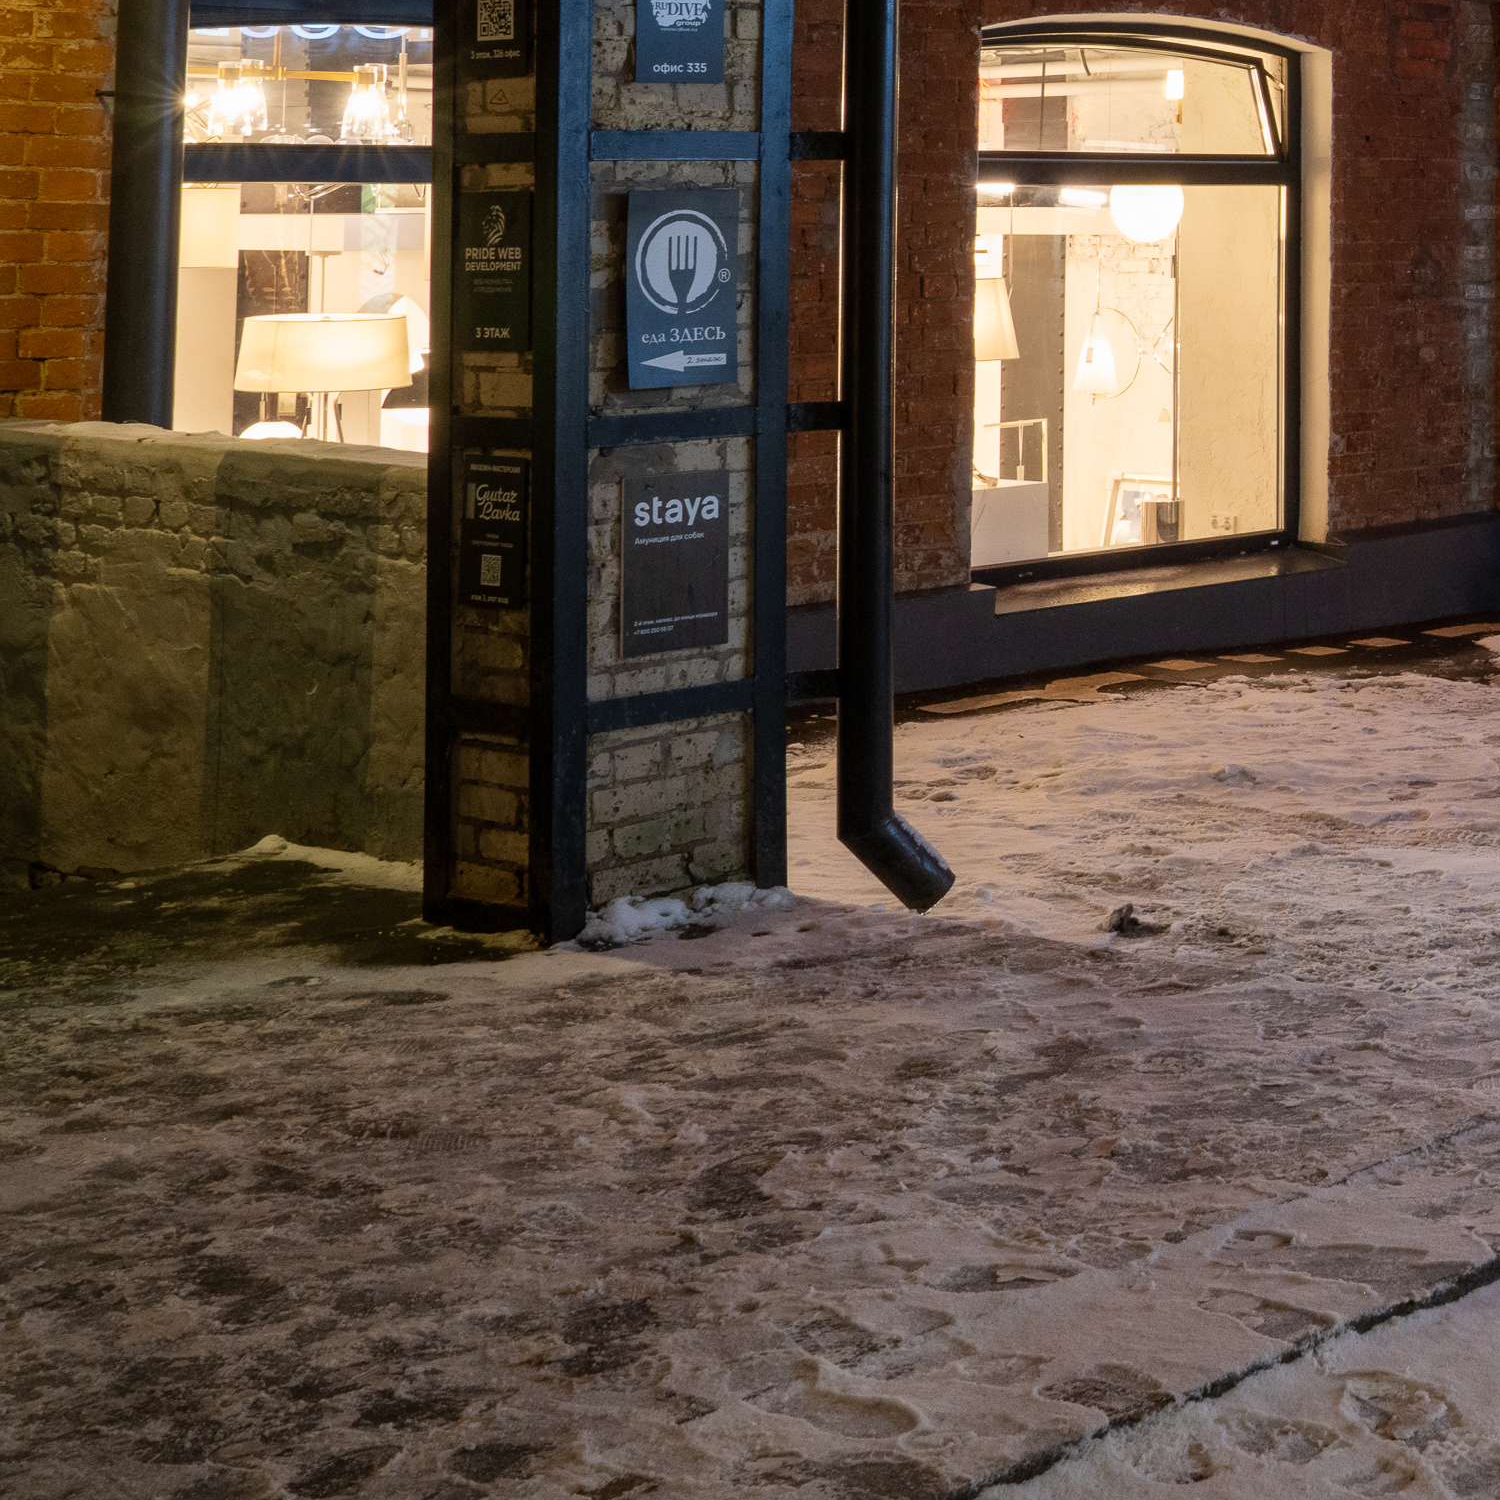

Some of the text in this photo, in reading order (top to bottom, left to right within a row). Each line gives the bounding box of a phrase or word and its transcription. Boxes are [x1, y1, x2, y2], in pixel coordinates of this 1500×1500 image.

[505, 48, 521, 59] офис
[653, 62, 707, 74] офис 335
[465, 247, 522, 260] PRIDE WEB
[465, 261, 522, 271] DEVELOPMENT
[475, 327, 510, 338] 3 ЭТАЖ
[641, 326, 726, 344] еда ЗДЕСЬ
[687, 356, 693, 364] 2
[476, 483, 518, 506] Guitar
[479, 501, 521, 521] Lavka
[634, 495, 719, 527] staya
[634, 531, 705, 546] Амуниция для собак
